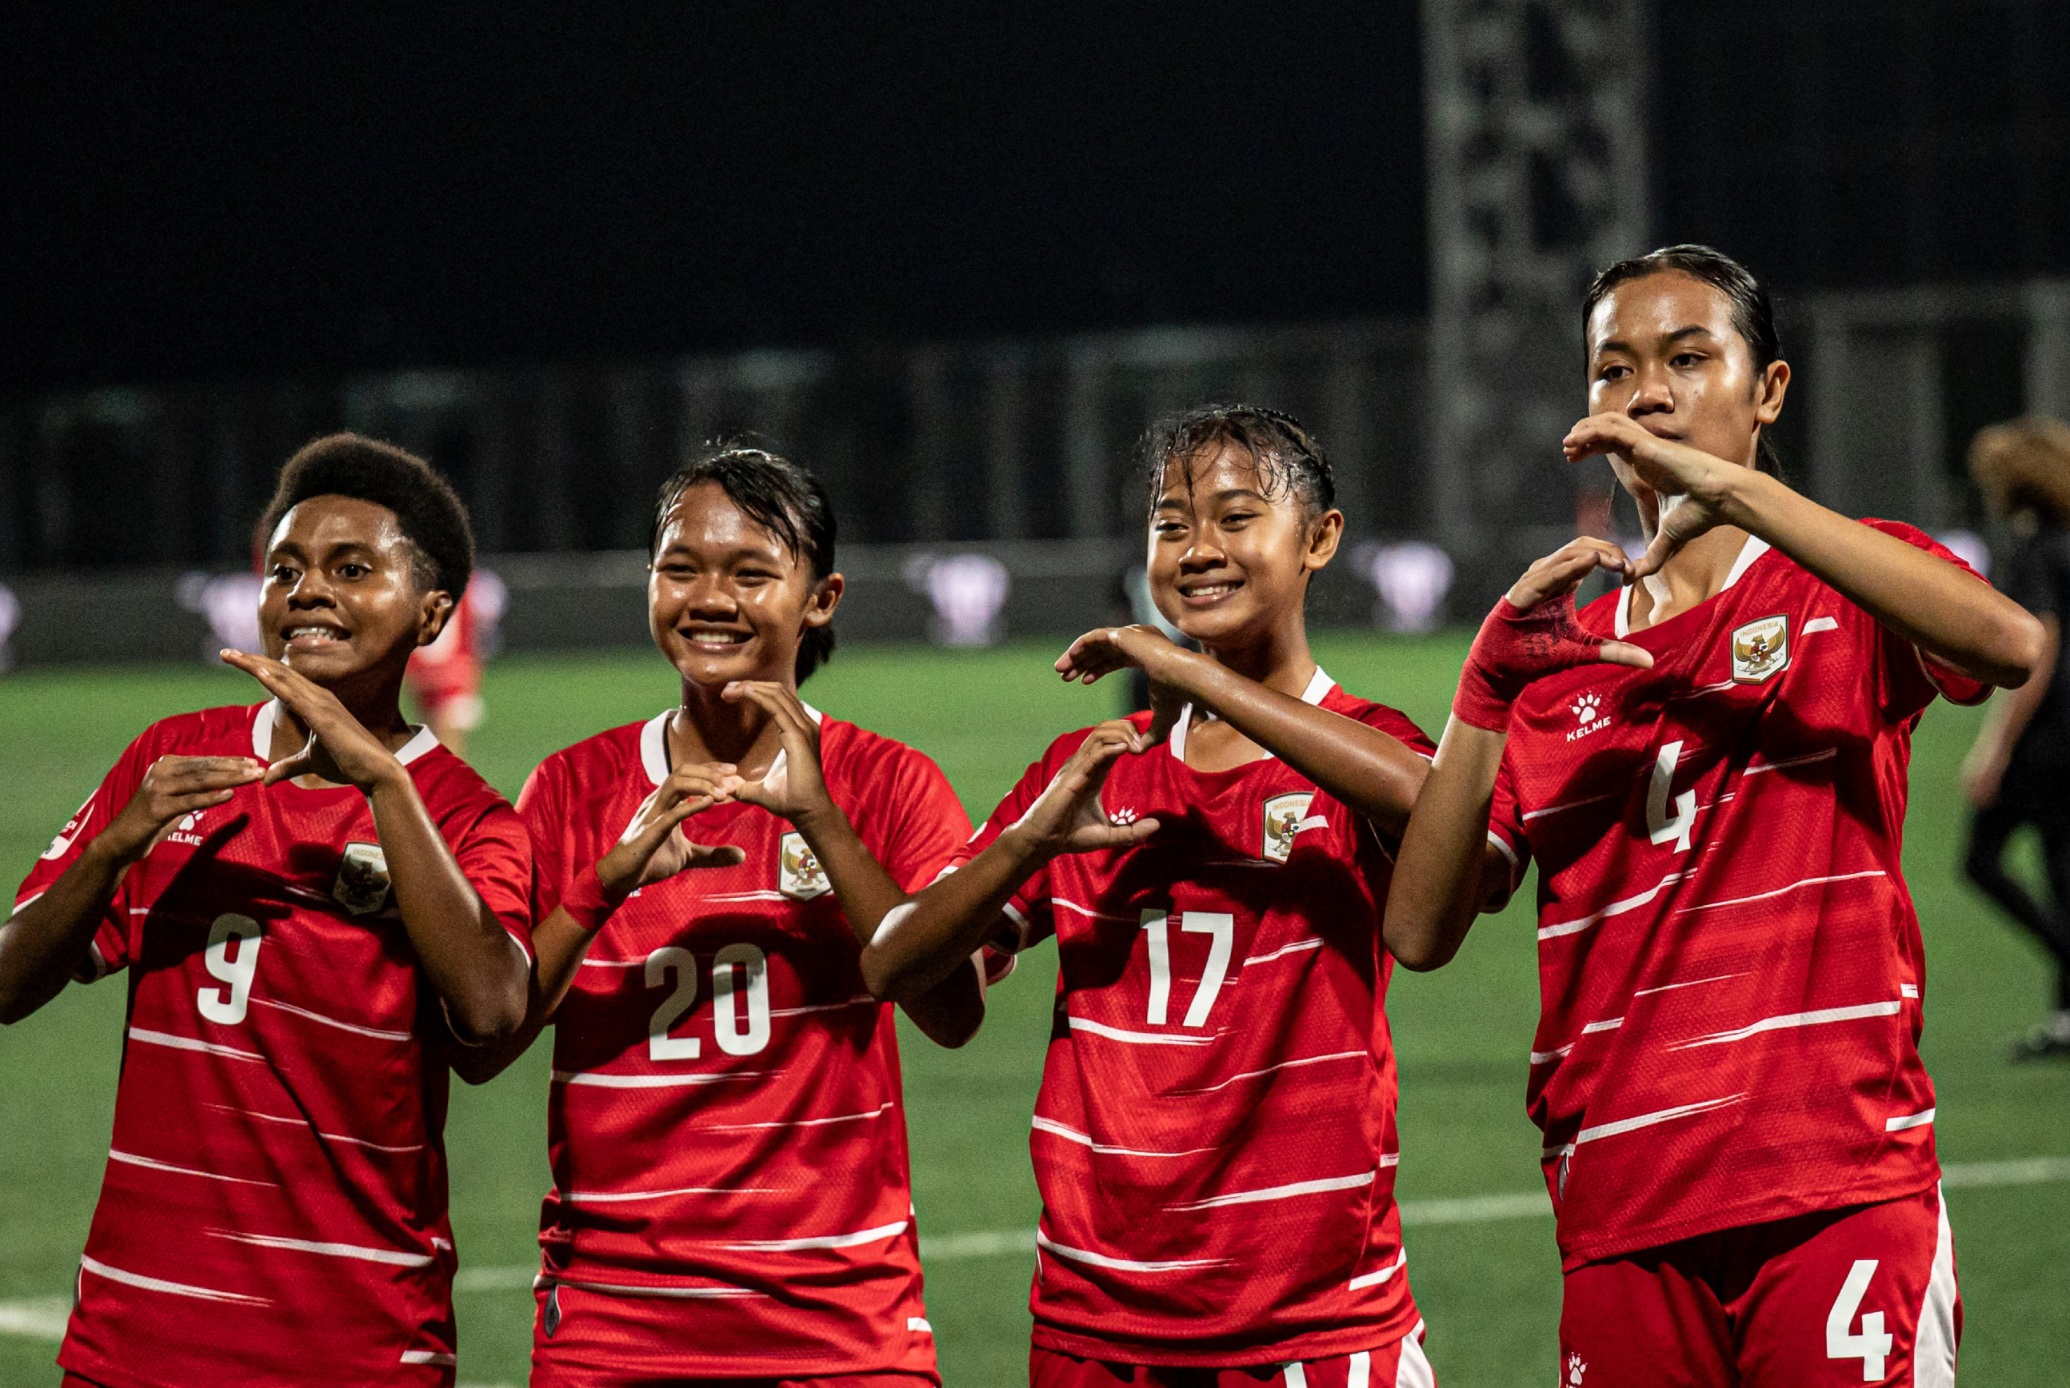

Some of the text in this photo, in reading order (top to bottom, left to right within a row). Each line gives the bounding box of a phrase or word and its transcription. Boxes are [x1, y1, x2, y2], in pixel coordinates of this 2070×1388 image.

[1740, 621, 1779, 637] INDONESIA
[1566, 716, 1611, 742] KELME
[167, 832, 203, 846] ELME
[1646, 740, 1698, 854] 4
[198, 913, 261, 1025] 9
[645, 943, 770, 1061] 20
[1140, 908, 1233, 1028] 17
[1826, 1260, 1893, 1381] 4
